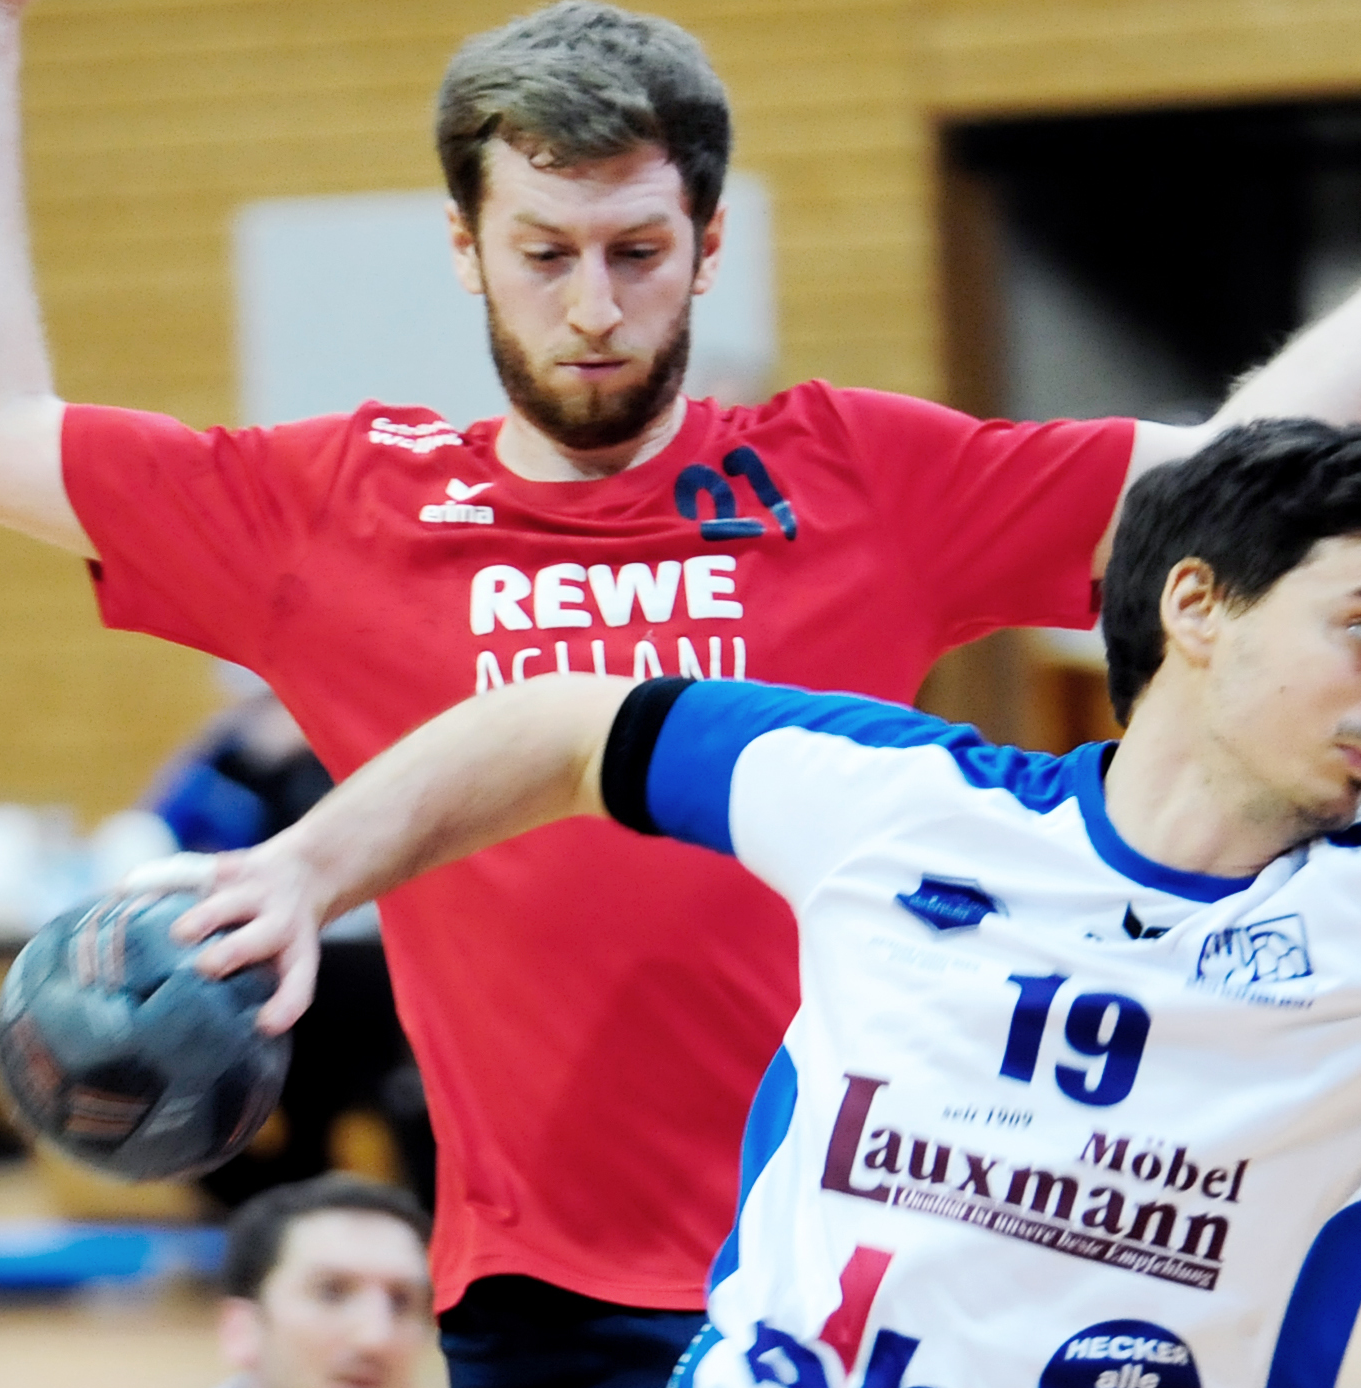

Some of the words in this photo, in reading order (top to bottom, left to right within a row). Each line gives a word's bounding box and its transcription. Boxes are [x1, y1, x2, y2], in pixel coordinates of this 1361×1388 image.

[419, 500, 494, 525] erima
[674, 446, 797, 541] 21
[470, 555, 744, 636] REWE
[999, 970, 1153, 1107] 19
[819, 1071, 1229, 1264] Lauxmann
[1079, 1130, 1251, 1203] Möbel
[1064, 1335, 1188, 1366] HECKER
